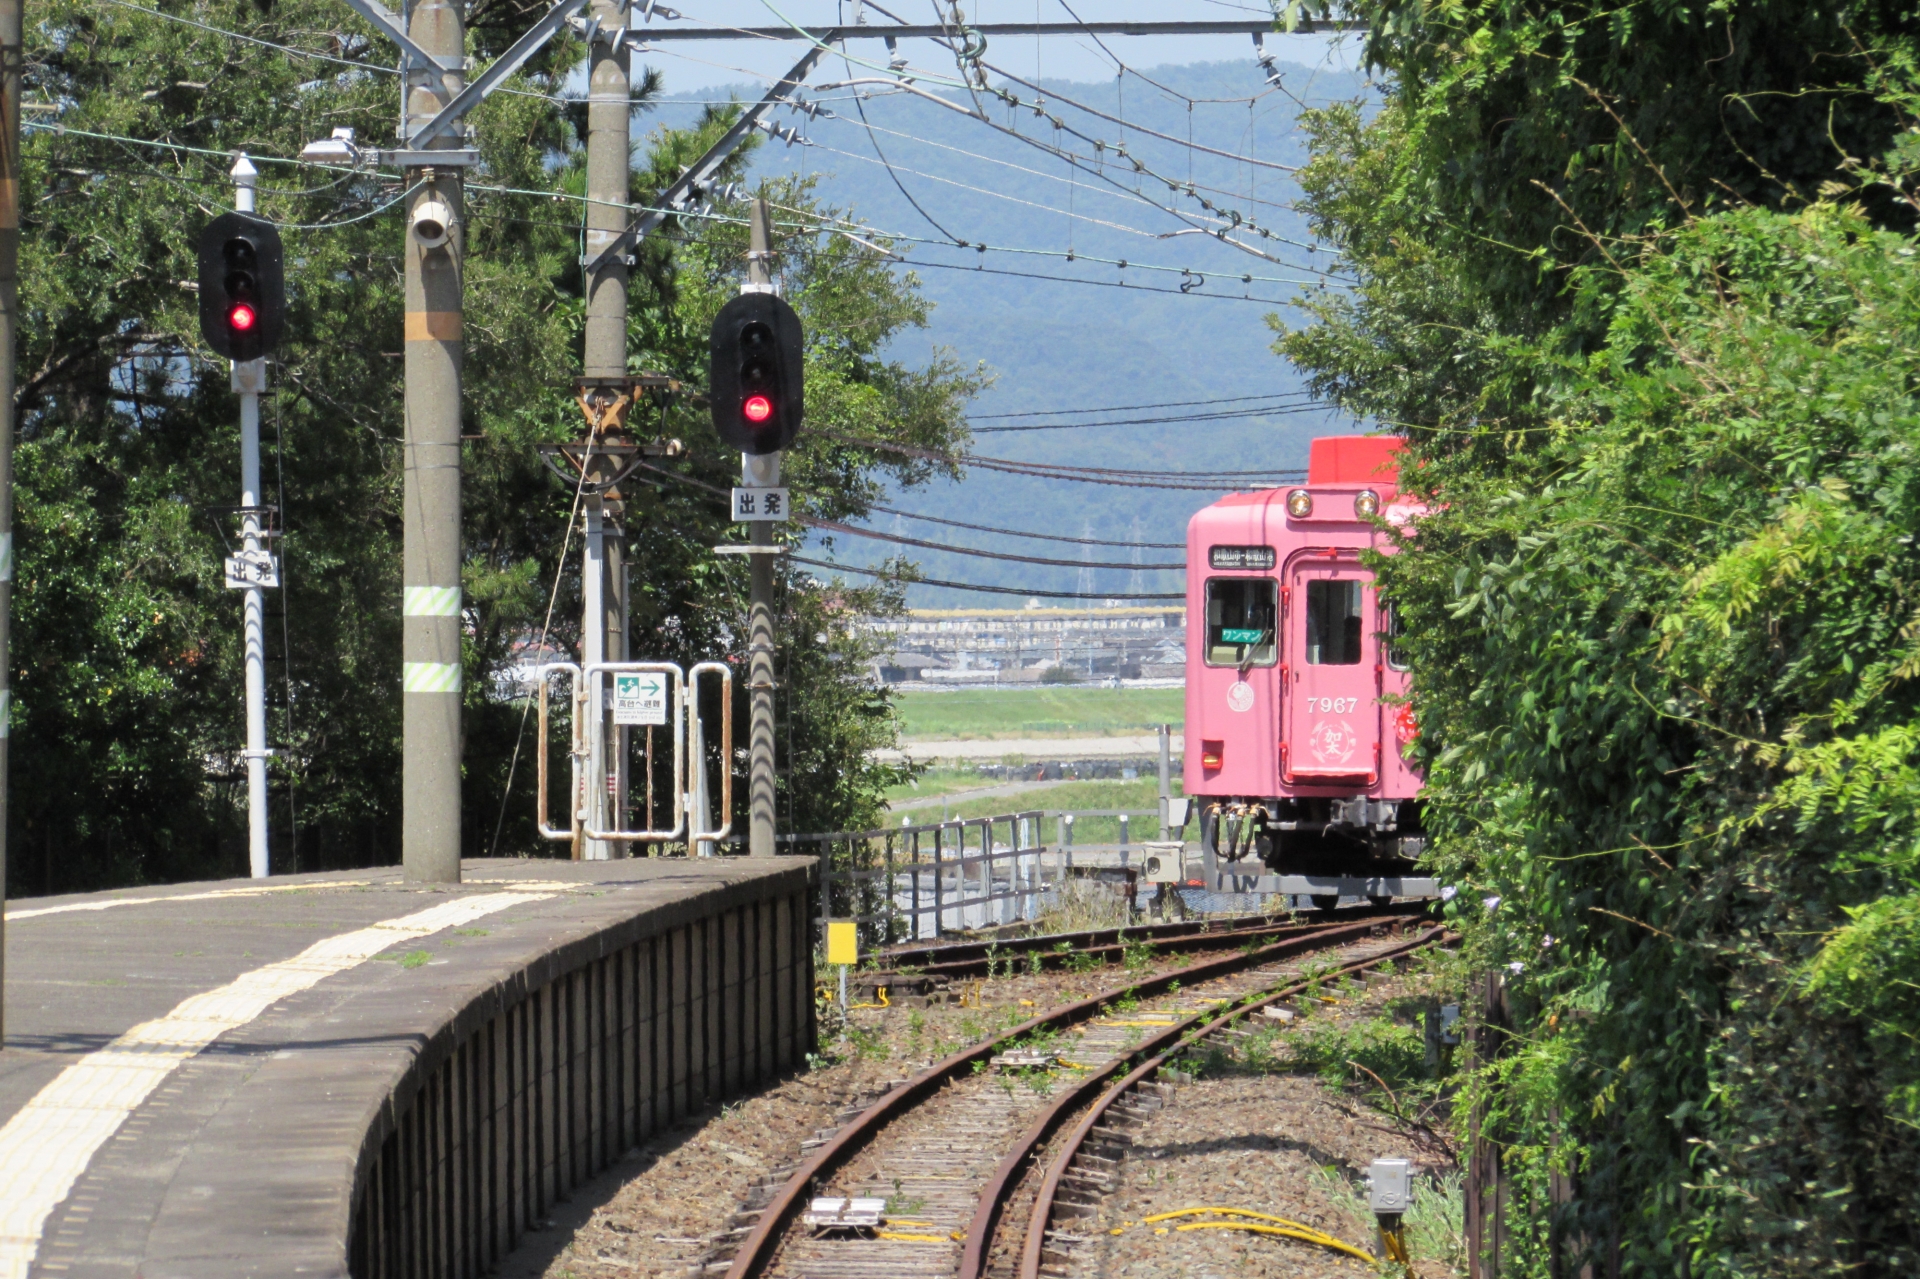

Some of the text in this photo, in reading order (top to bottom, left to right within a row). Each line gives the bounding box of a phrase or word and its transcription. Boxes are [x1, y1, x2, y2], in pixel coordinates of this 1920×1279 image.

[740, 492, 781, 515] 出発
[232, 561, 272, 582] 出発
[1223, 630, 1261, 641] ワンマン
[618, 699, 661, 708] 高台へ避難
[1307, 697, 1358, 714] 7967
[1323, 728, 1342, 755] 加太
